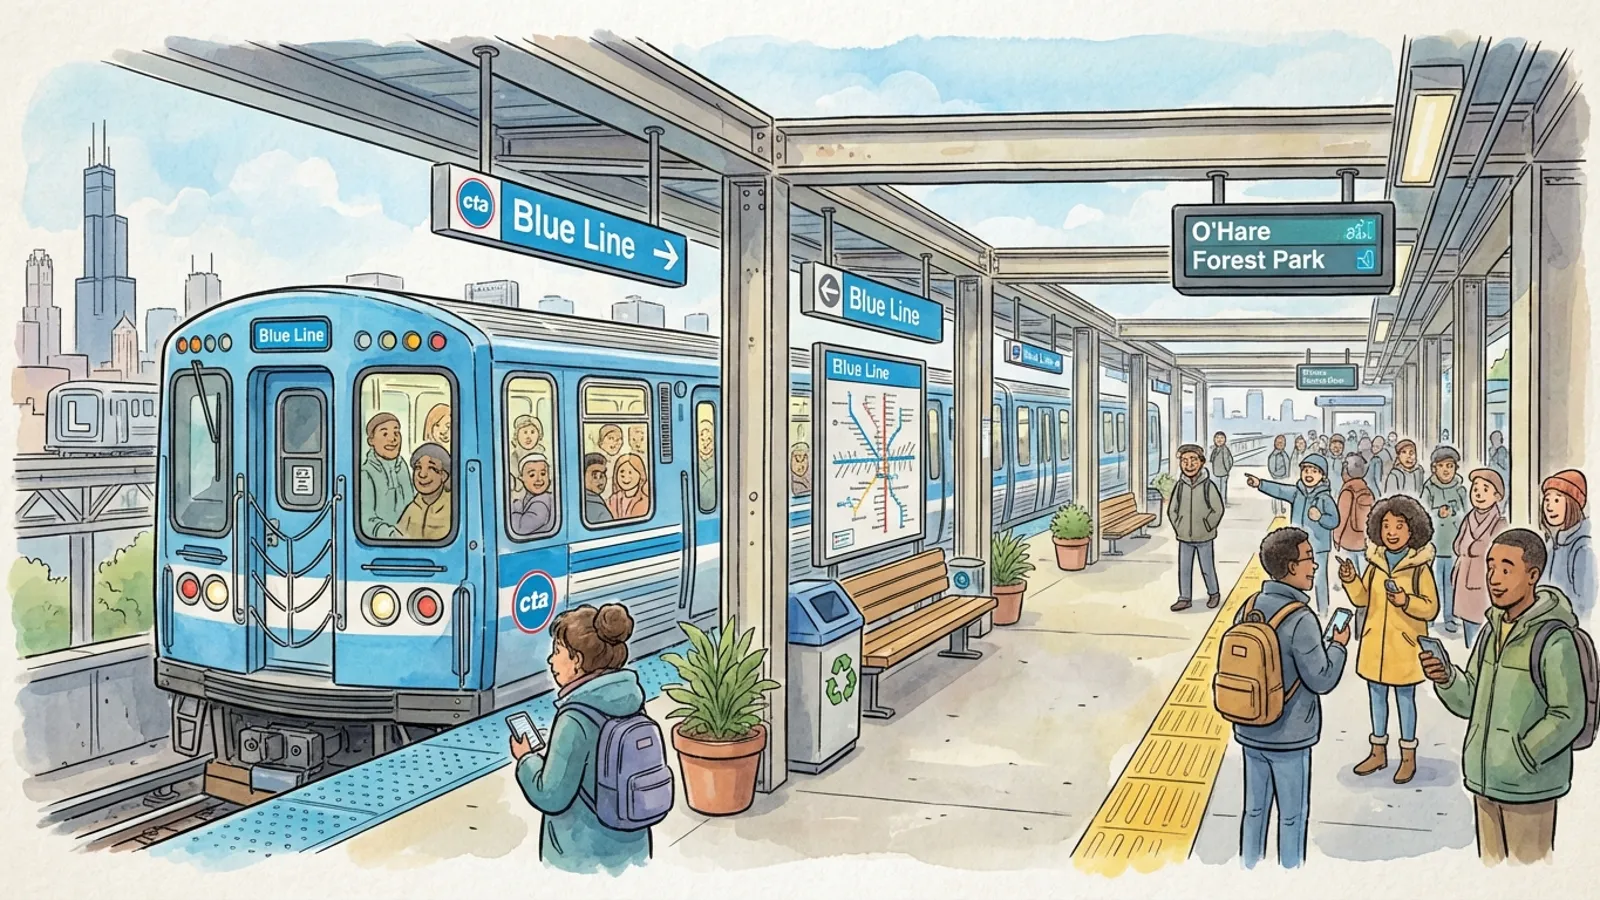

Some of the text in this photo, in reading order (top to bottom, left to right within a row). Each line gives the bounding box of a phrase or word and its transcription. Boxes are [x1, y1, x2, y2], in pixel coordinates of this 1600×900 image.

[462, 194, 489, 213] cta
[513, 198, 635, 260] Blue Line
[1192, 221, 1271, 242] O'Hare
[1193, 250, 1326, 270] Forest Park
[850, 286, 920, 326] Blue Line
[259, 327, 324, 343] Blue Line
[833, 358, 890, 380] Blue Line
[67, 400, 91, 432] L
[519, 591, 549, 613] cta
